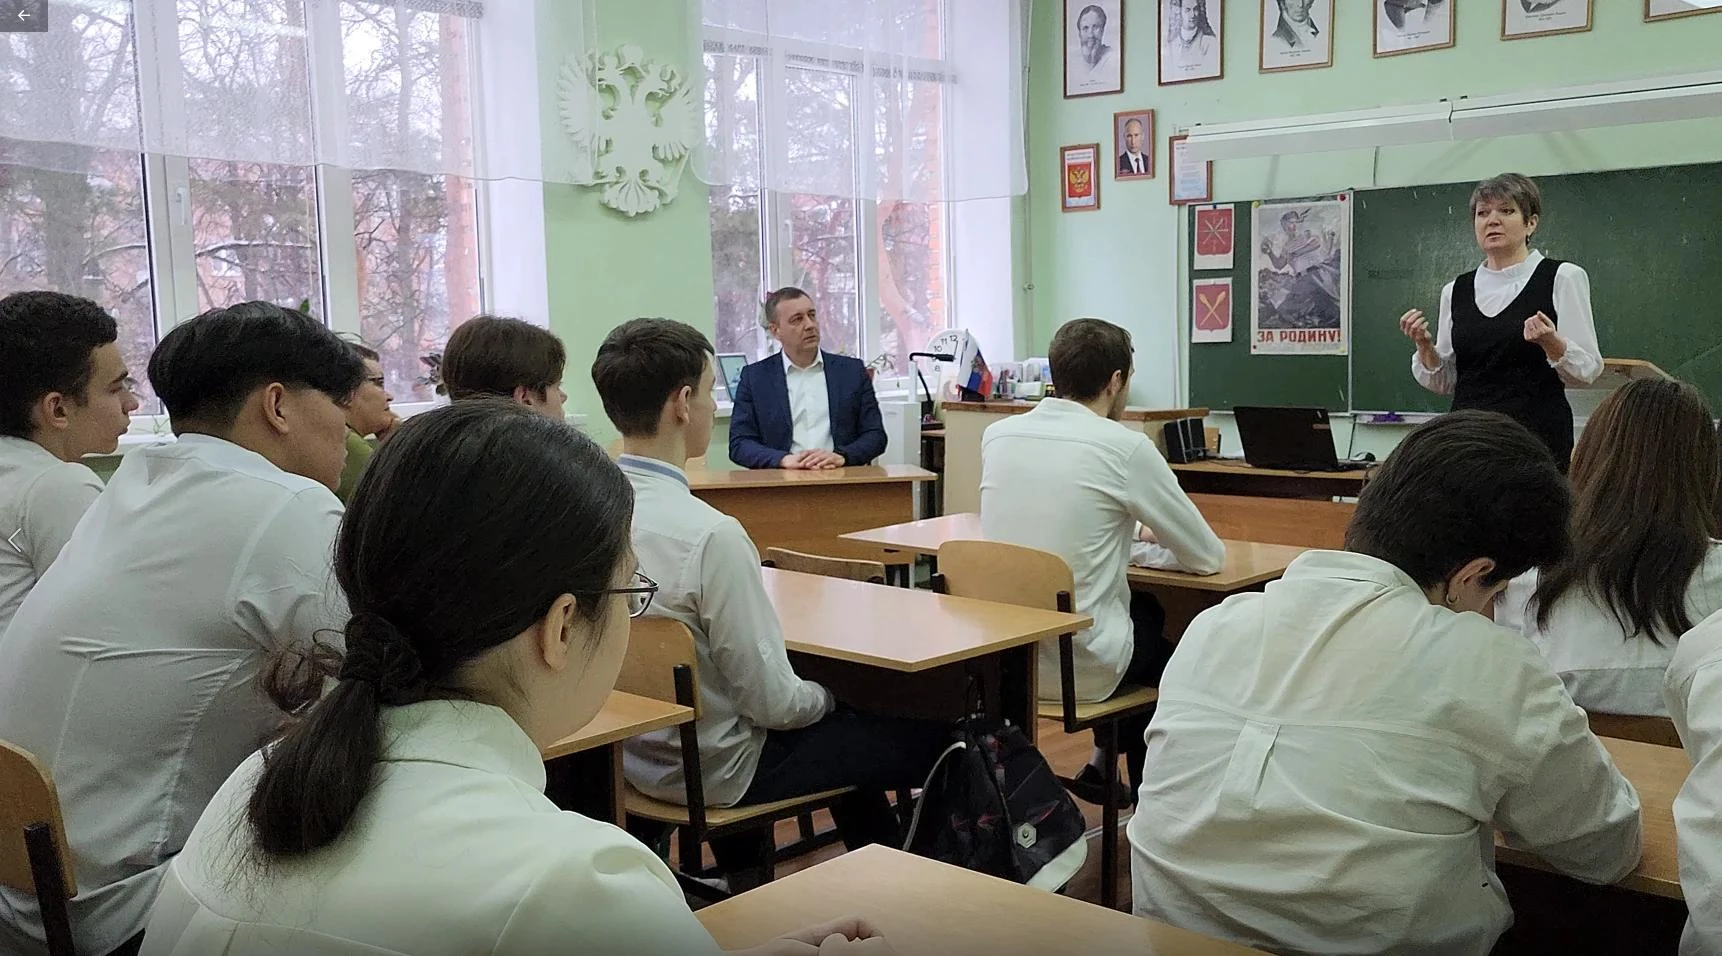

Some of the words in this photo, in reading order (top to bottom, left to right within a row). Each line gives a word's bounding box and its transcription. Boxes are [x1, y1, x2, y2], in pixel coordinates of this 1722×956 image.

[949, 334, 958, 342] 12
[1257, 330, 1274, 343] ЗА
[1279, 330, 1342, 343] РОДИНУ!
[941, 337, 948, 345] 11
